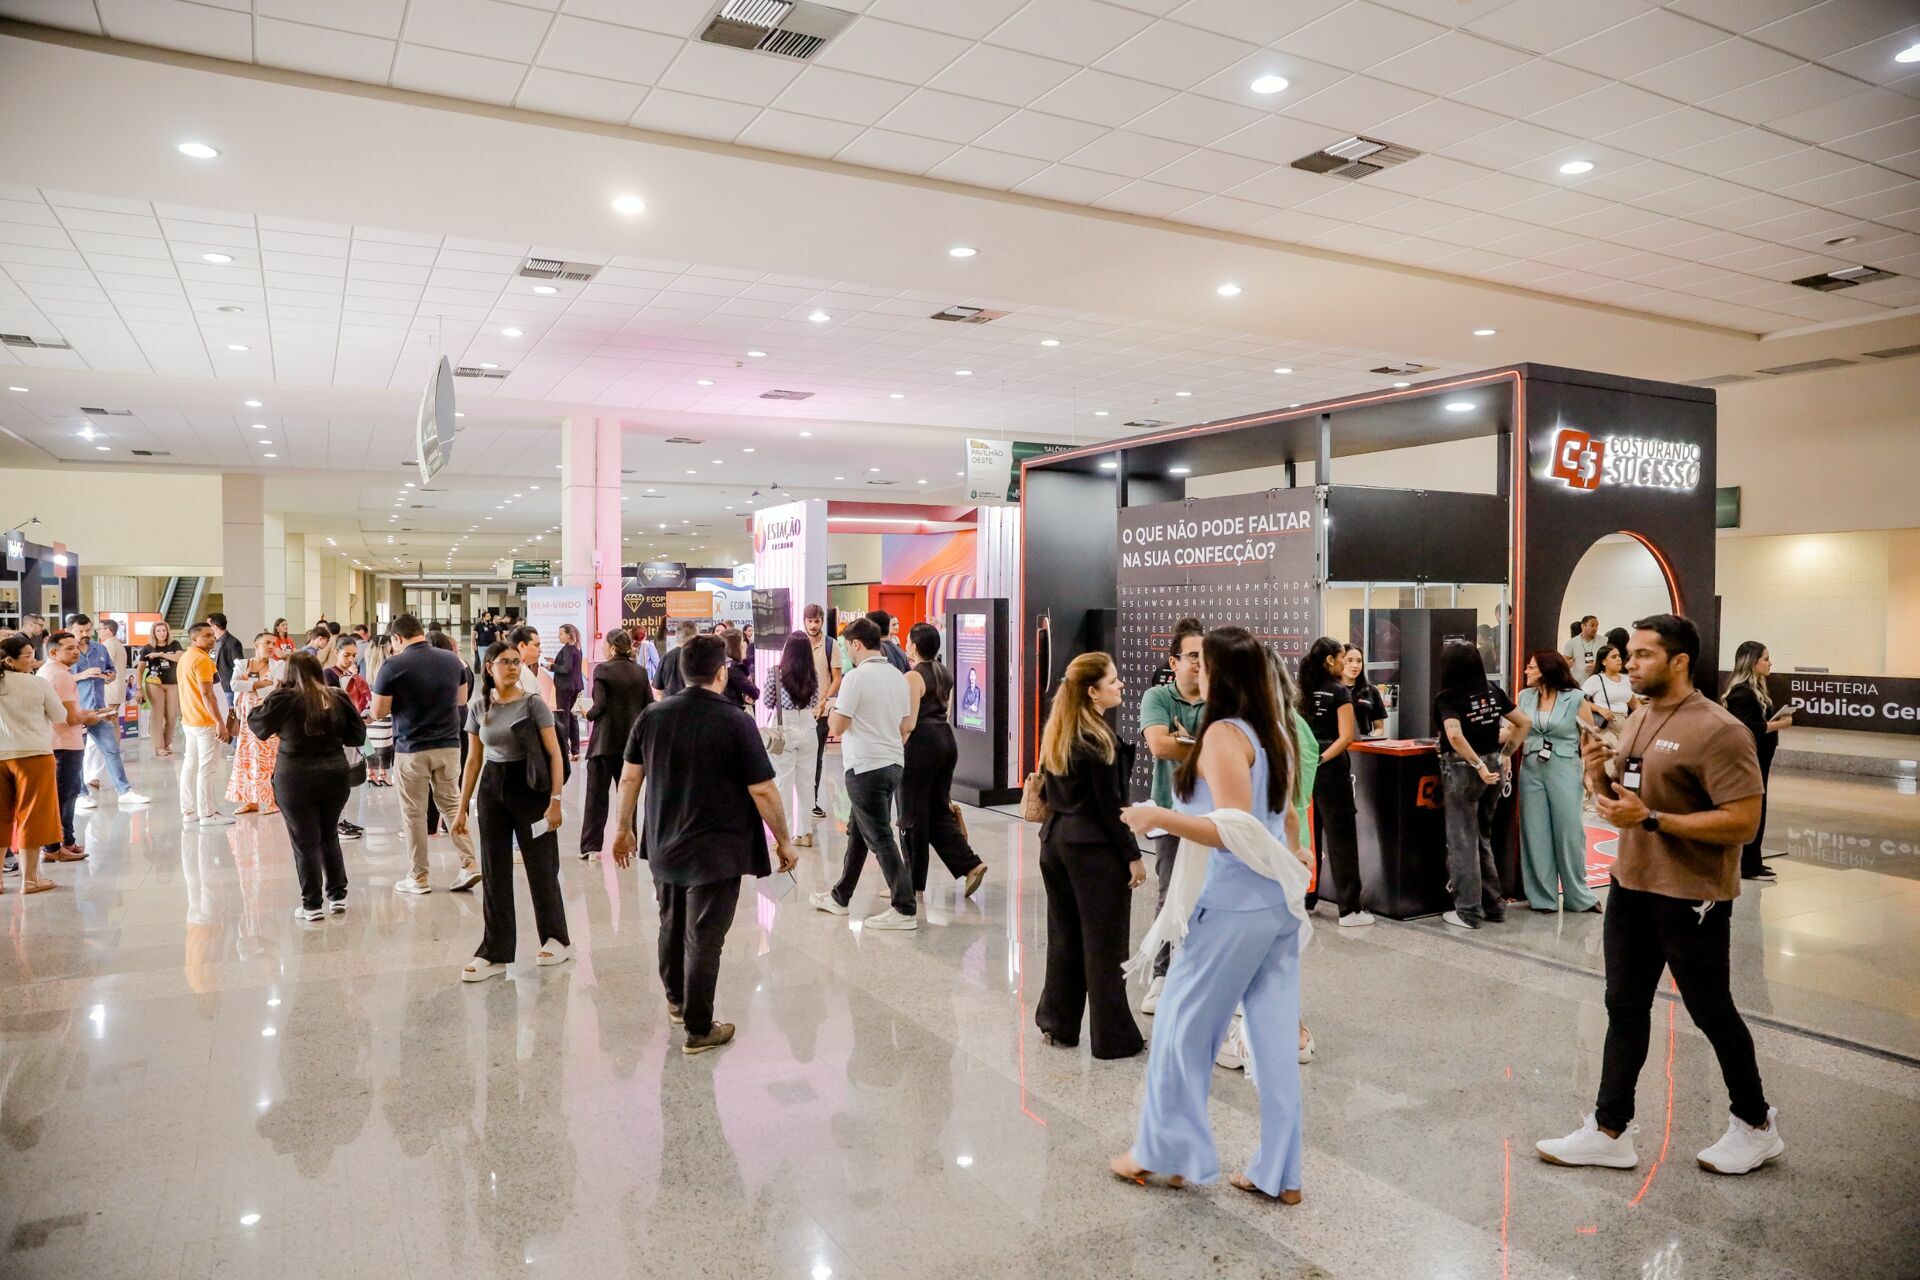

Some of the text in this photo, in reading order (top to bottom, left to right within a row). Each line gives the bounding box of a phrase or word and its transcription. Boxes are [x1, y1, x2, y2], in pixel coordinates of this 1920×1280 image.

[971, 448, 1004, 457] PAVILHÃO
[1611, 437, 1701, 460] COSTURANDO
[971, 457, 993, 465] OESTE
[767, 516, 801, 540] ESTAÇÃO
[1122, 510, 1311, 546] O QUE NÃO PODE FALTAR
[1123, 538, 1276, 568] NA SUA CONFECÇÃO?
[530, 600, 581, 610] BEM-VINDO
[730, 600, 751, 611] ECOFIN
[621, 617, 662, 626] ontabil
[1791, 680, 1879, 696] BILHETERIA
[1791, 697, 1876, 718] Público
